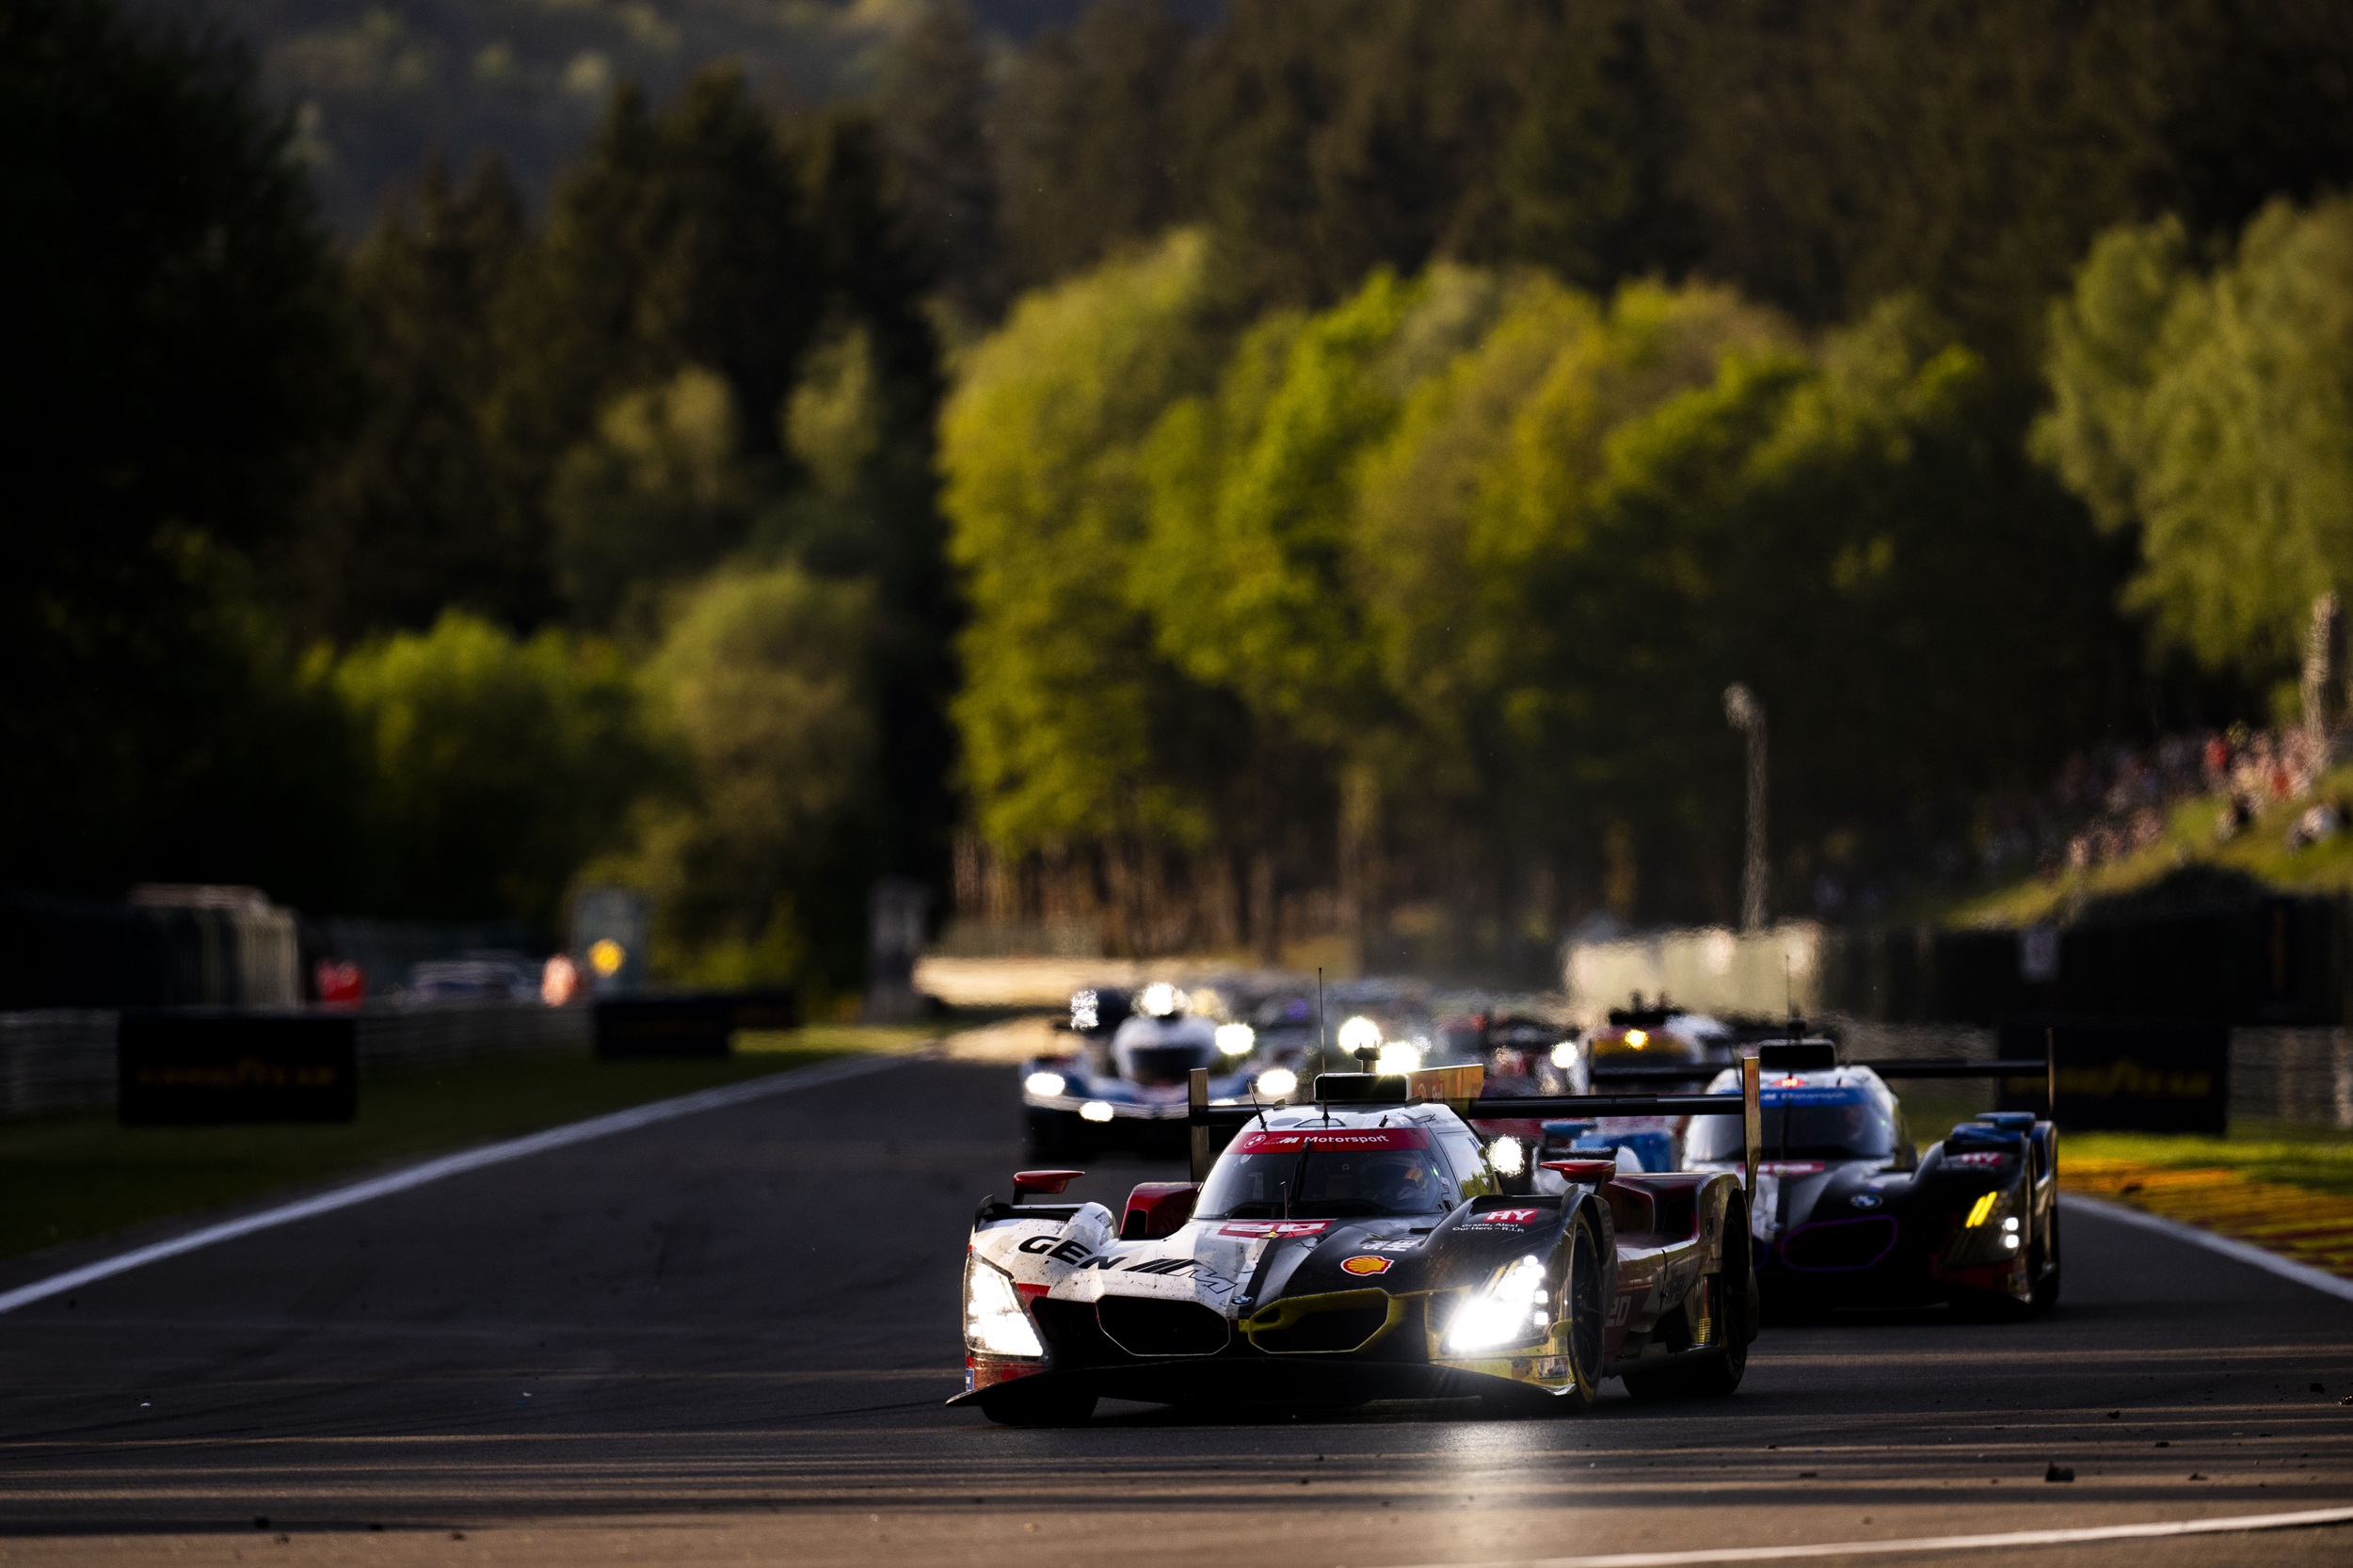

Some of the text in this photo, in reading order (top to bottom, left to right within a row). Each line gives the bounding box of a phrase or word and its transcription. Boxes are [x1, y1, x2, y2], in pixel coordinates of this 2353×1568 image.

[1304, 1134, 1390, 1144] Motorsport
[1487, 1210, 1535, 1221] HY
[1018, 1235, 1128, 1271] GEN
[1604, 1295, 1632, 1327] 20
